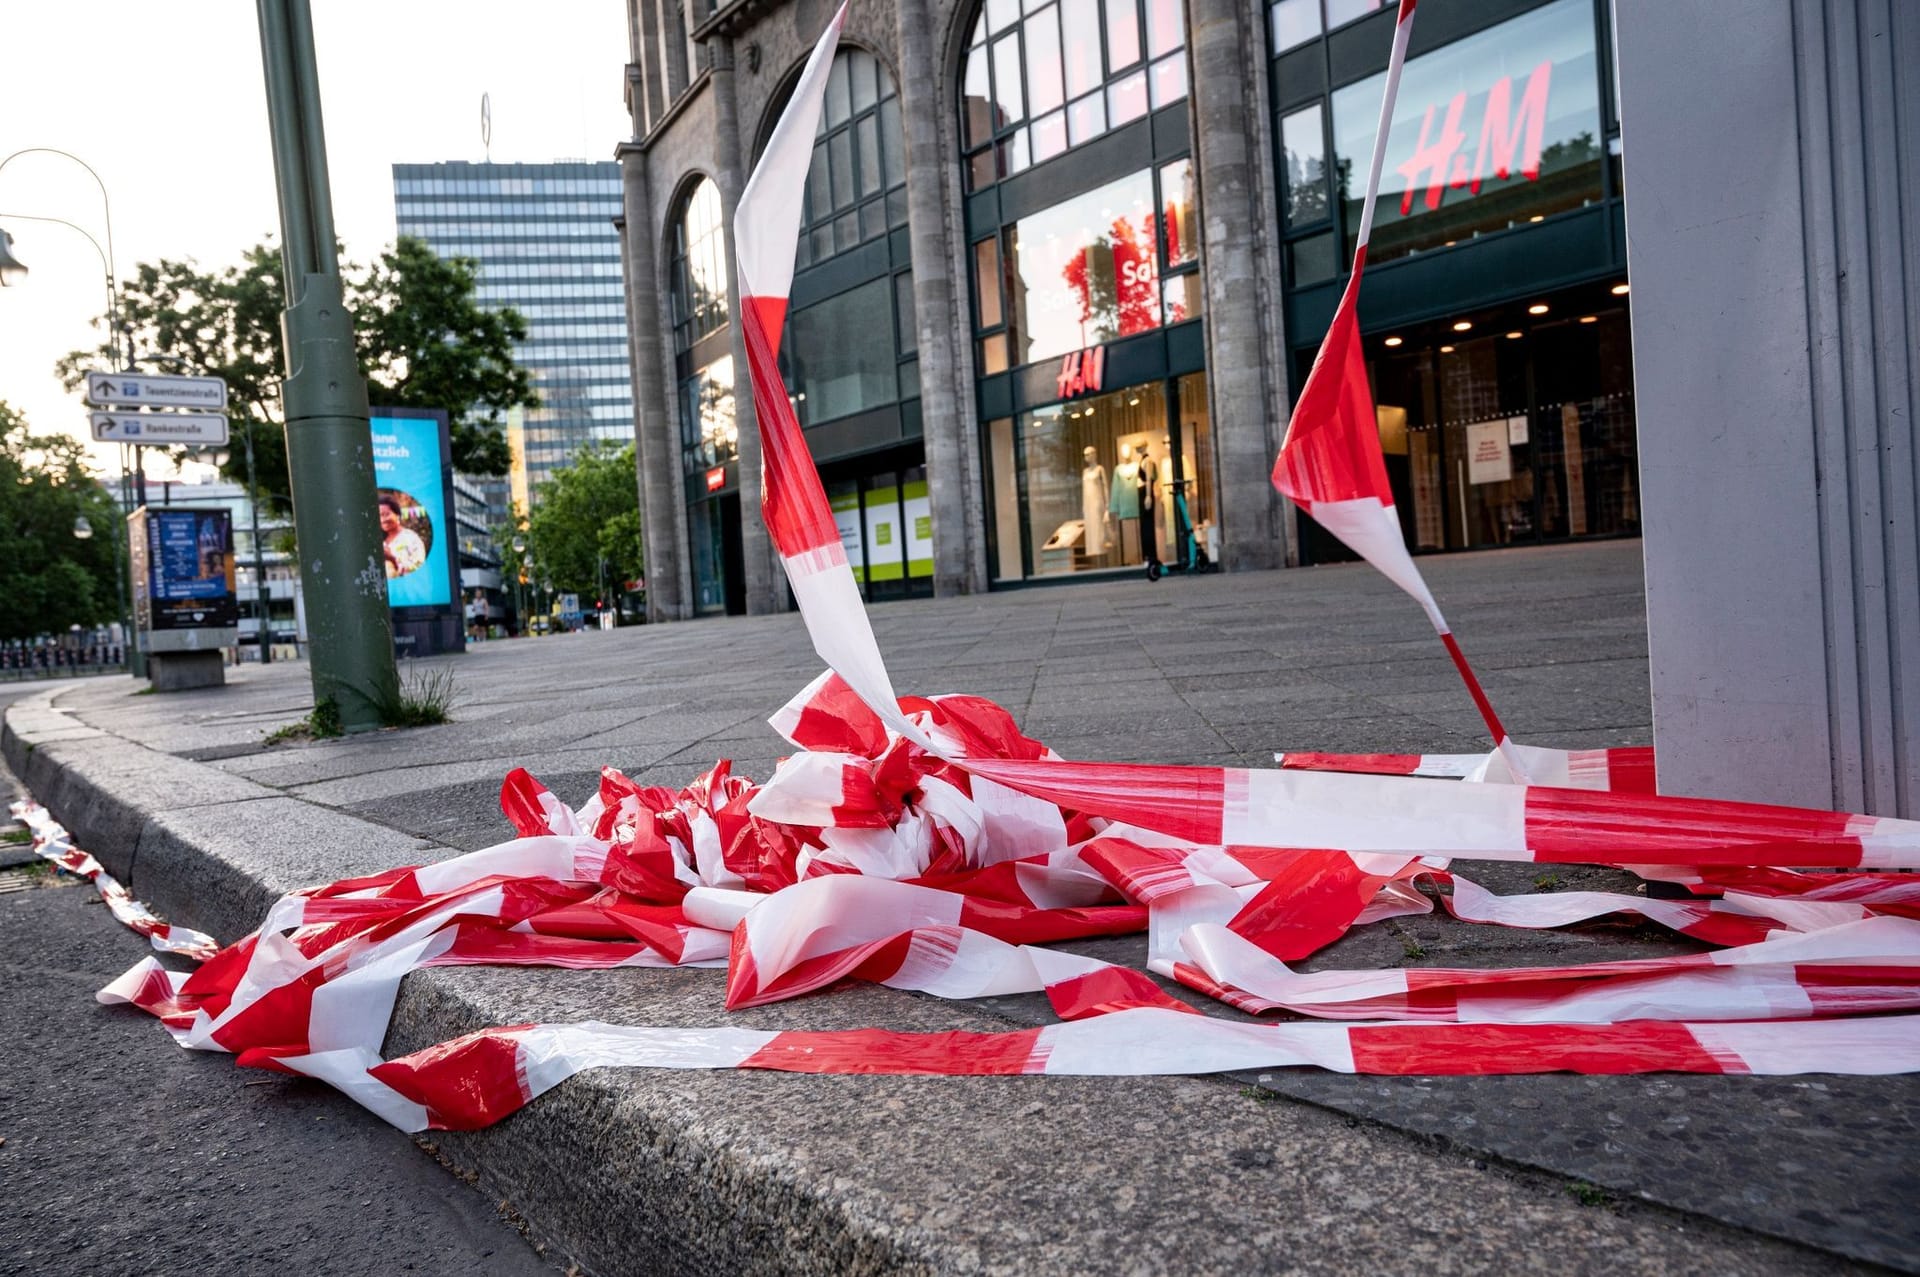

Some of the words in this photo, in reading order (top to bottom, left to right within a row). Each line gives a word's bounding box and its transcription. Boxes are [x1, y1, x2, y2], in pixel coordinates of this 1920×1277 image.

[1397, 59, 1552, 216] H&M
[1122, 252, 1159, 287] Sal
[1056, 345, 1105, 399] H&M
